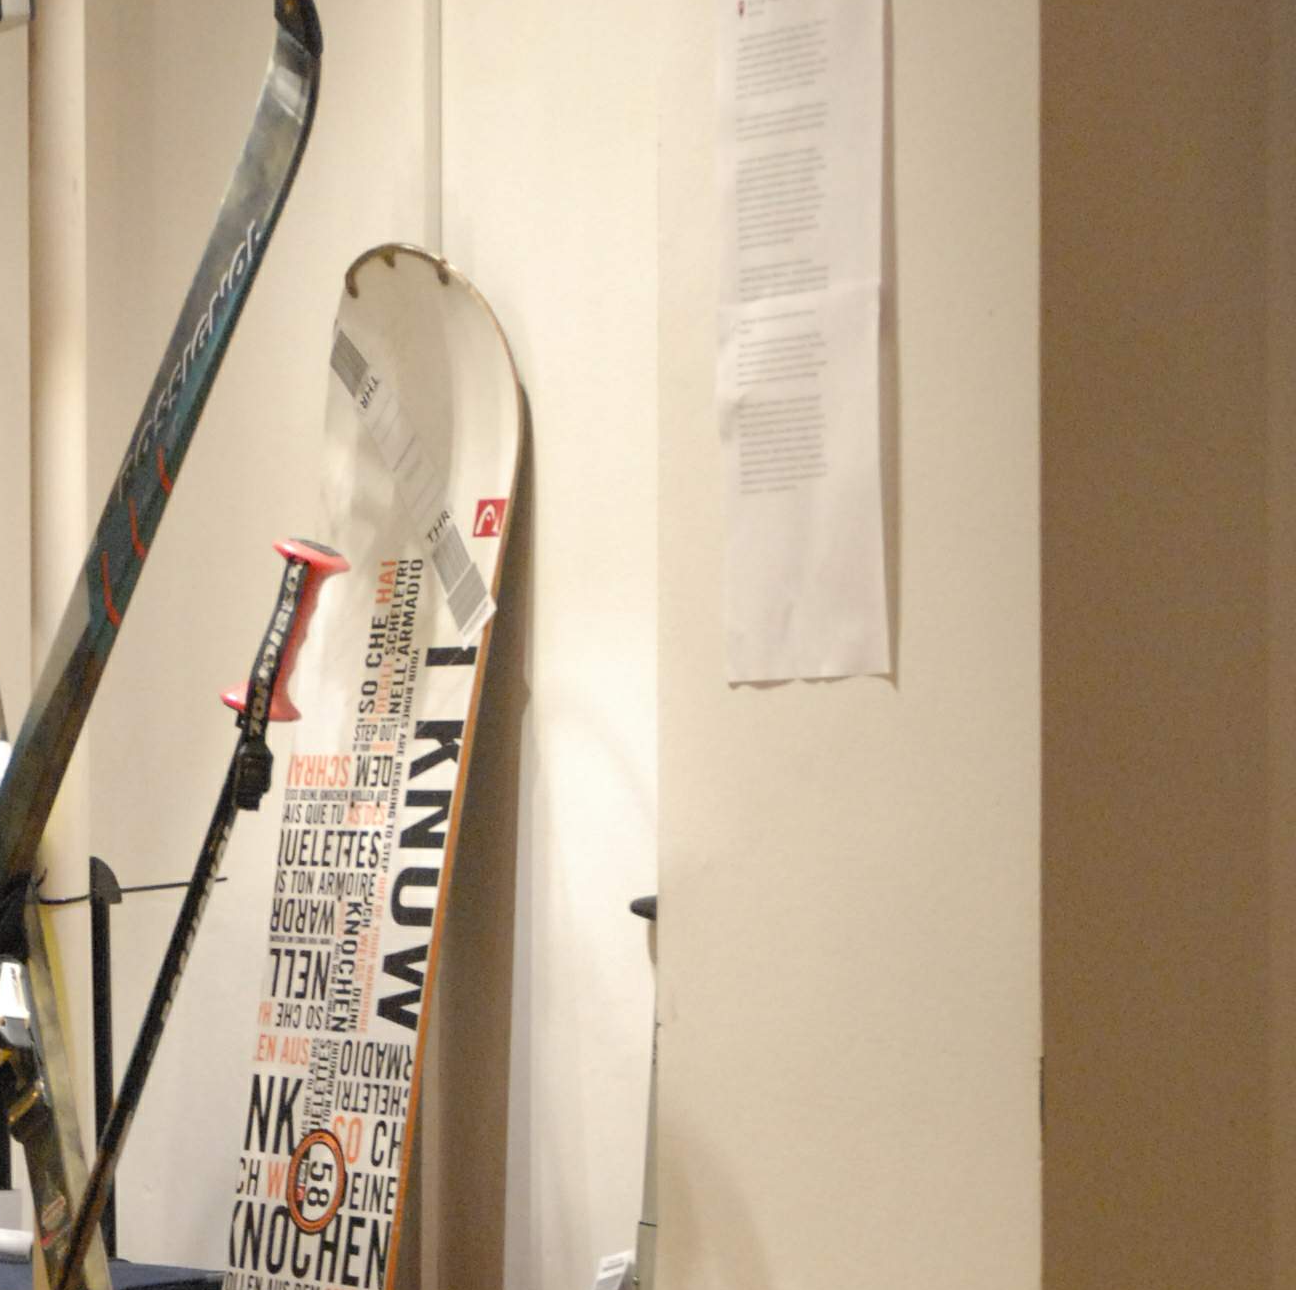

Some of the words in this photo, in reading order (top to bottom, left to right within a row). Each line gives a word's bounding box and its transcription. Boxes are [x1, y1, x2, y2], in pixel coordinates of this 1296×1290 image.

[375, 560, 397, 604] HAI
[384, 559, 410, 655] SCHELETRI
[365, 614, 389, 668] CHE
[389, 558, 424, 714] NELL'ARMADIO
[425, 646, 478, 667] I
[358, 680, 379, 714] SO
[354, 724, 379, 742] STEP
[355, 755, 394, 787] DEM
[304, 804, 328, 825] QUE
[331, 804, 345, 825] TU
[381, 842, 392, 873] STEP
[291, 870, 316, 894] TON
[317, 871, 377, 897] ARMOIRE
[376, 720, 465, 1031] KNOW
[269, 948, 332, 1001] NELL
[331, 901, 363, 1033] KNOCHEN
[275, 1002, 302, 1029] CHE
[305, 1005, 324, 1030] SO
[280, 1035, 310, 1066] AUS
[244, 1073, 304, 1157] NK
[307, 1161, 334, 1207] 58
